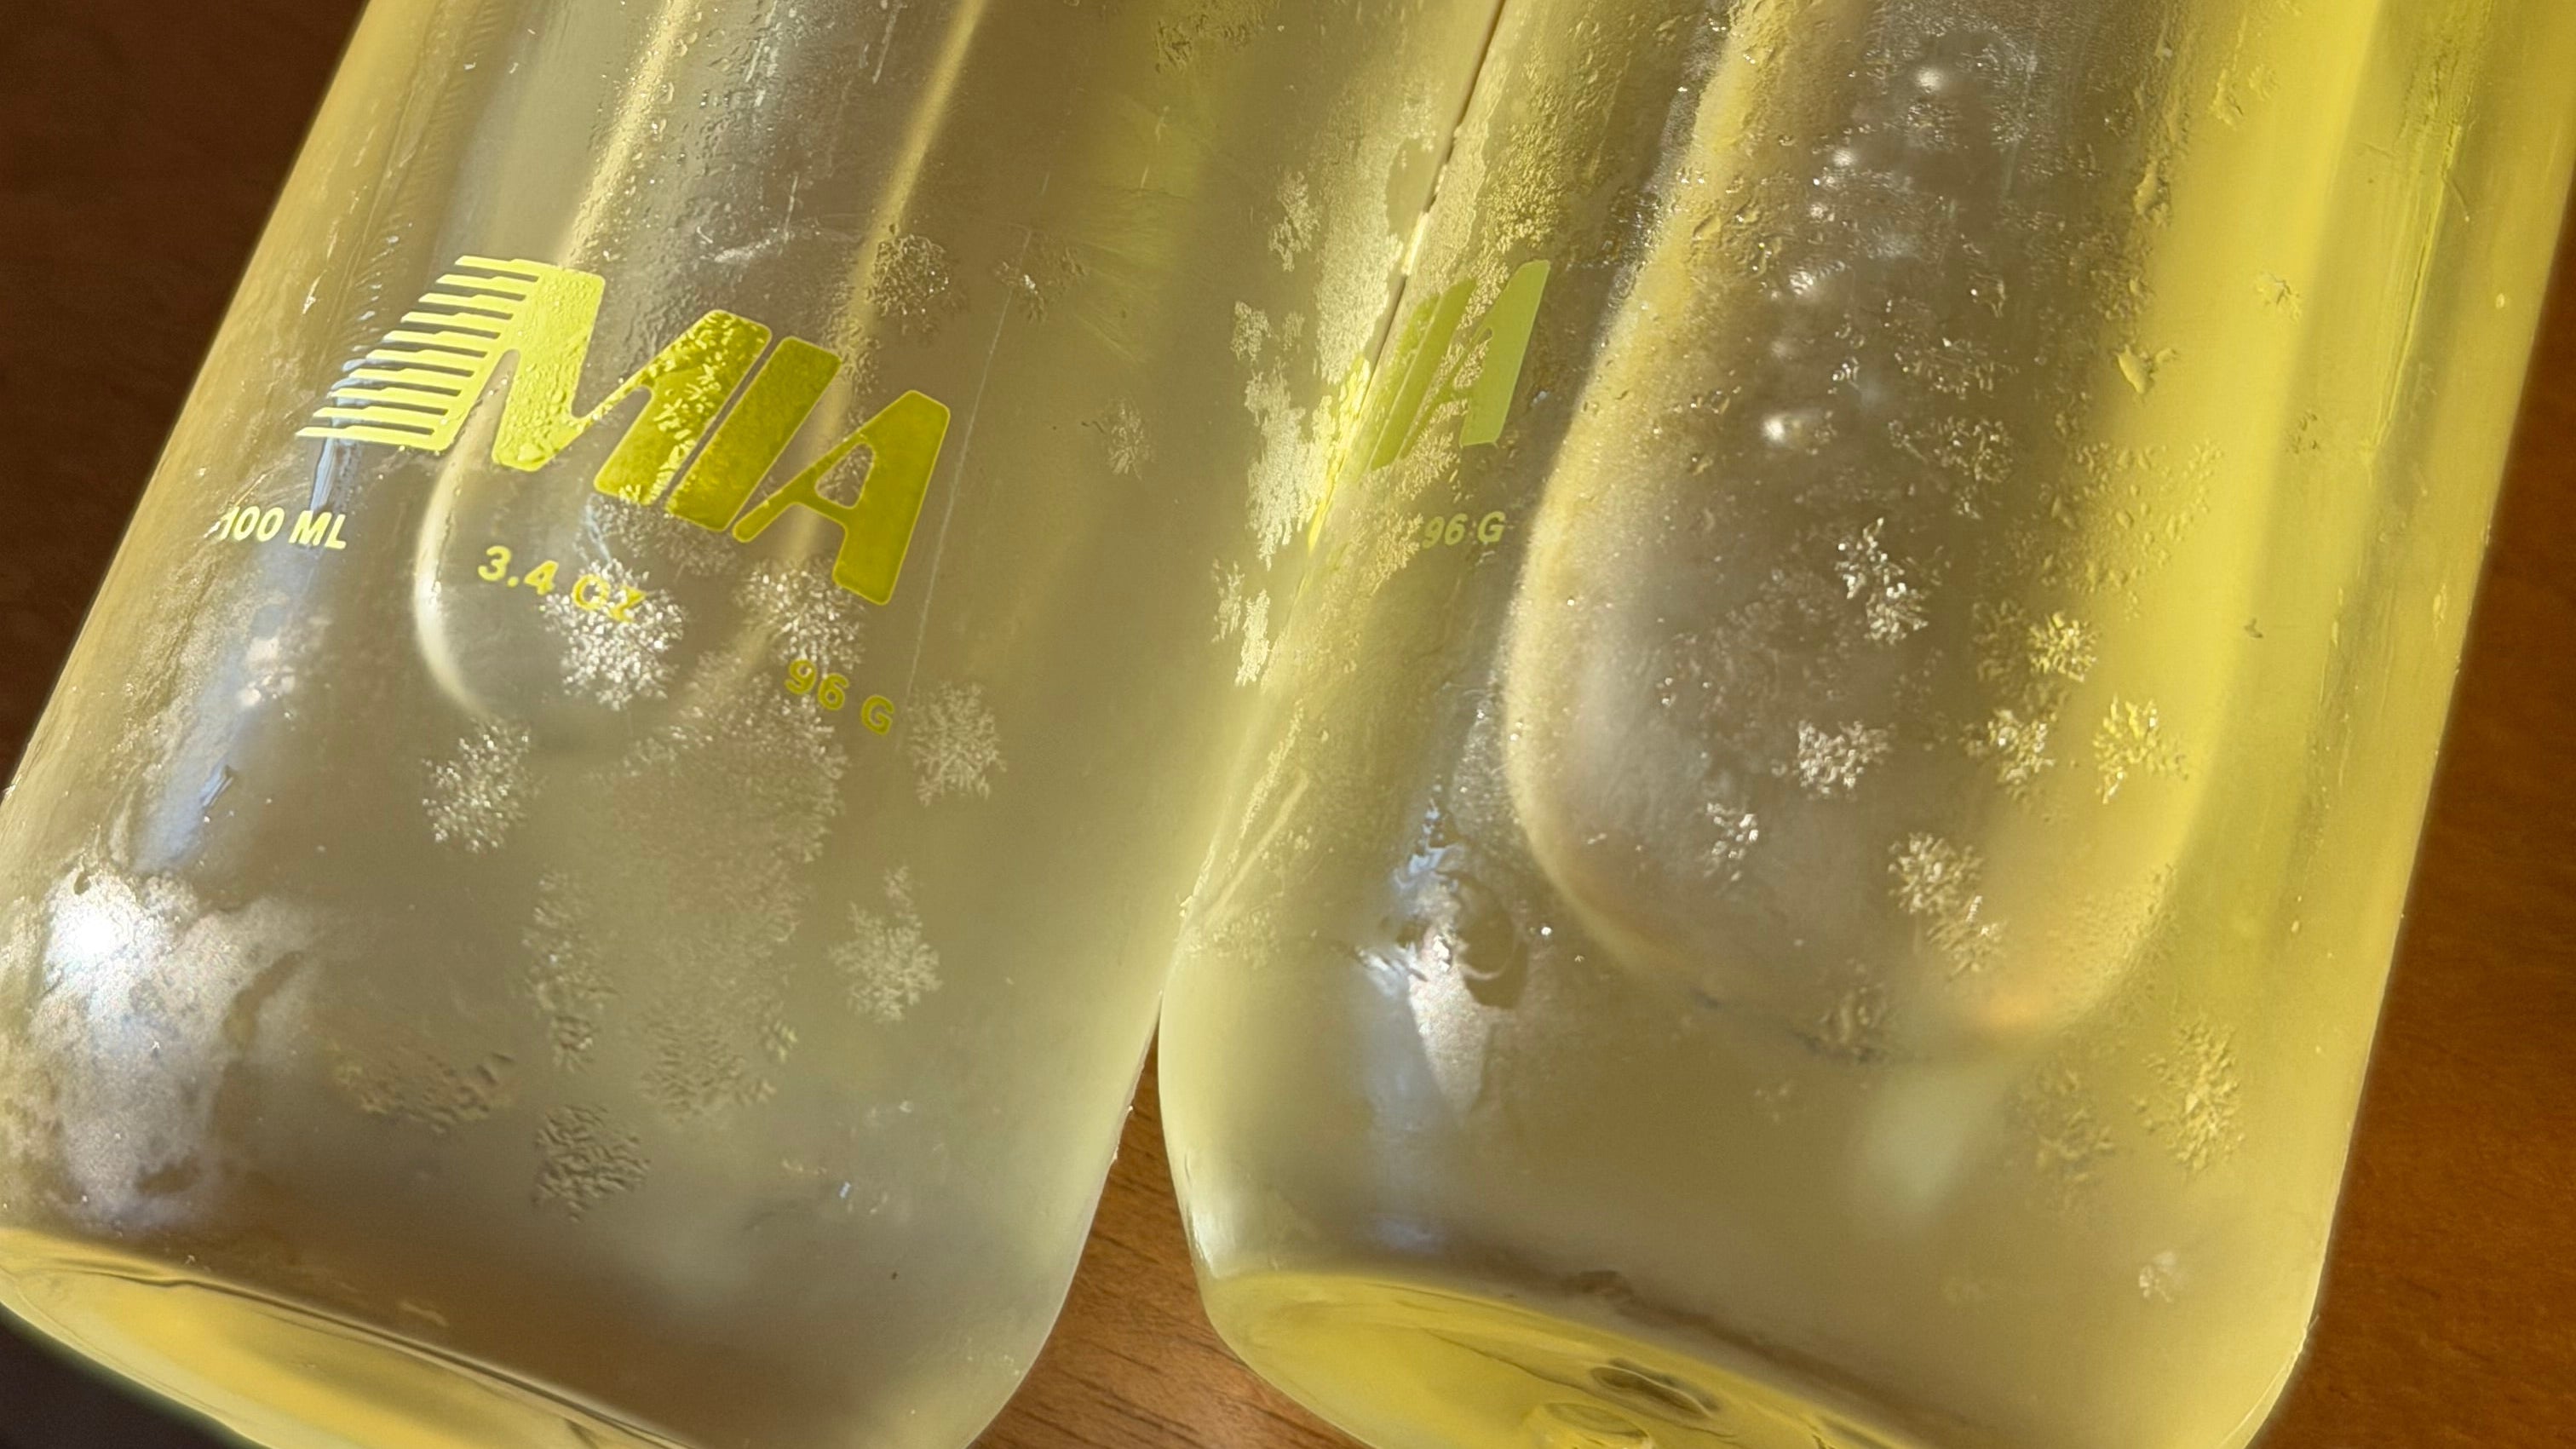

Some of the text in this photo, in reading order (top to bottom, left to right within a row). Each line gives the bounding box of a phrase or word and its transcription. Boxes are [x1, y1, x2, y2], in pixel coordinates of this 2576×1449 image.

[296, 256, 951, 605] MIA
[219, 506, 347, 549] 100 ML
[1422, 511, 1506, 549] 96 G
[477, 545, 559, 595] 3.4
[784, 658, 894, 735] 96 G
